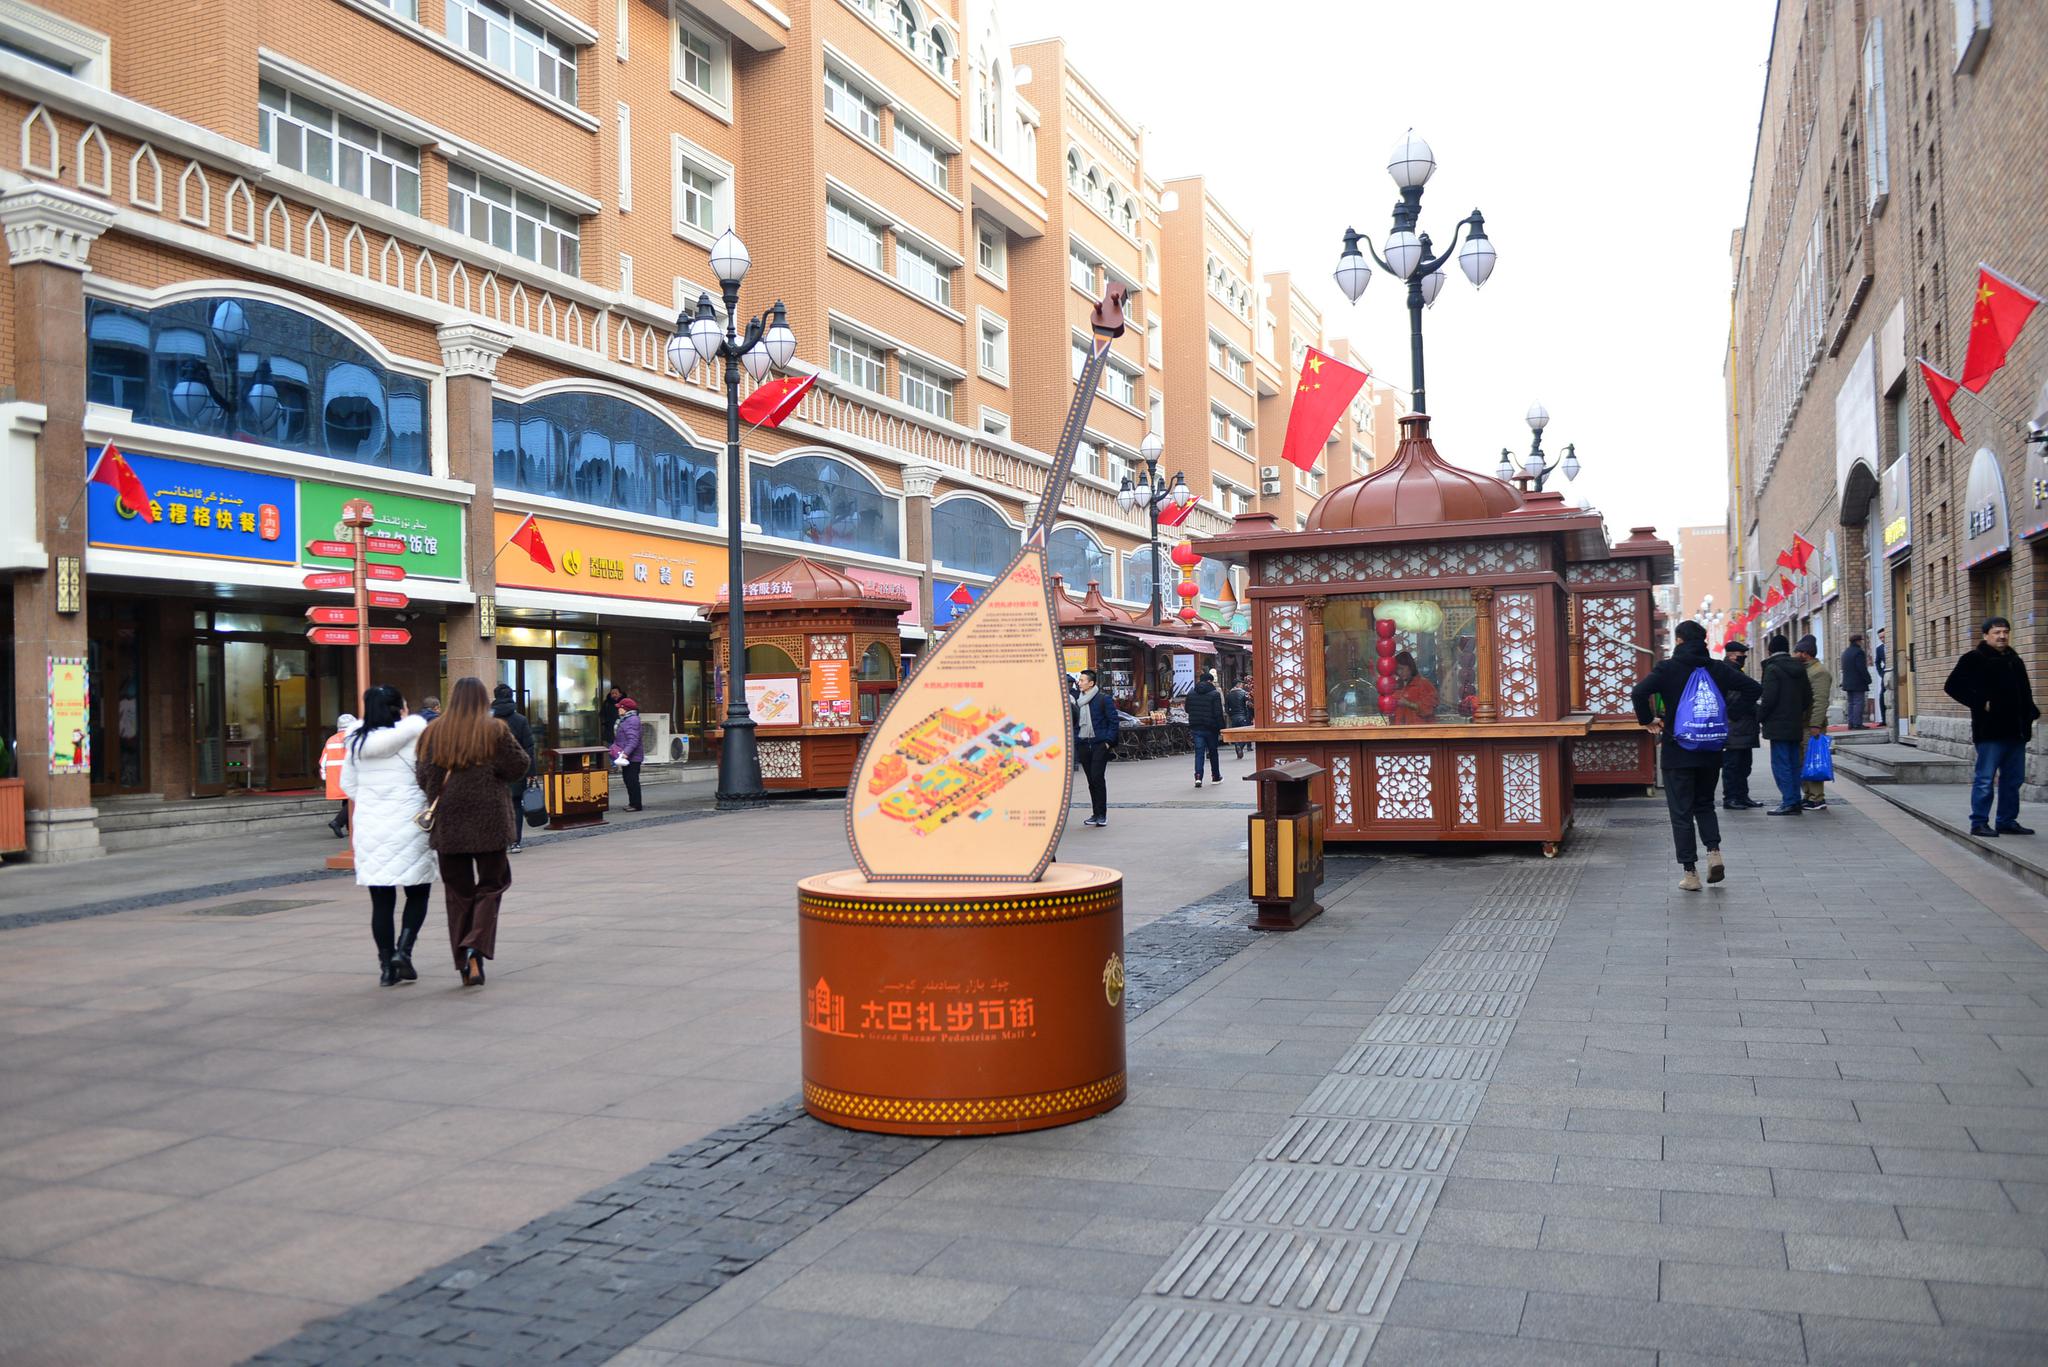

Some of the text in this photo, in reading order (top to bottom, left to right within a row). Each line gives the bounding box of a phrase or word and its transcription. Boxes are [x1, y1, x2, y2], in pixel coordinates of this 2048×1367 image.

[634, 563, 696, 587] 快餐店
[861, 998, 1034, 1031] 大巴扎步行街
[941, 1033, 997, 1042] Pedestrian
[1001, 1030, 1025, 1041] Mall
